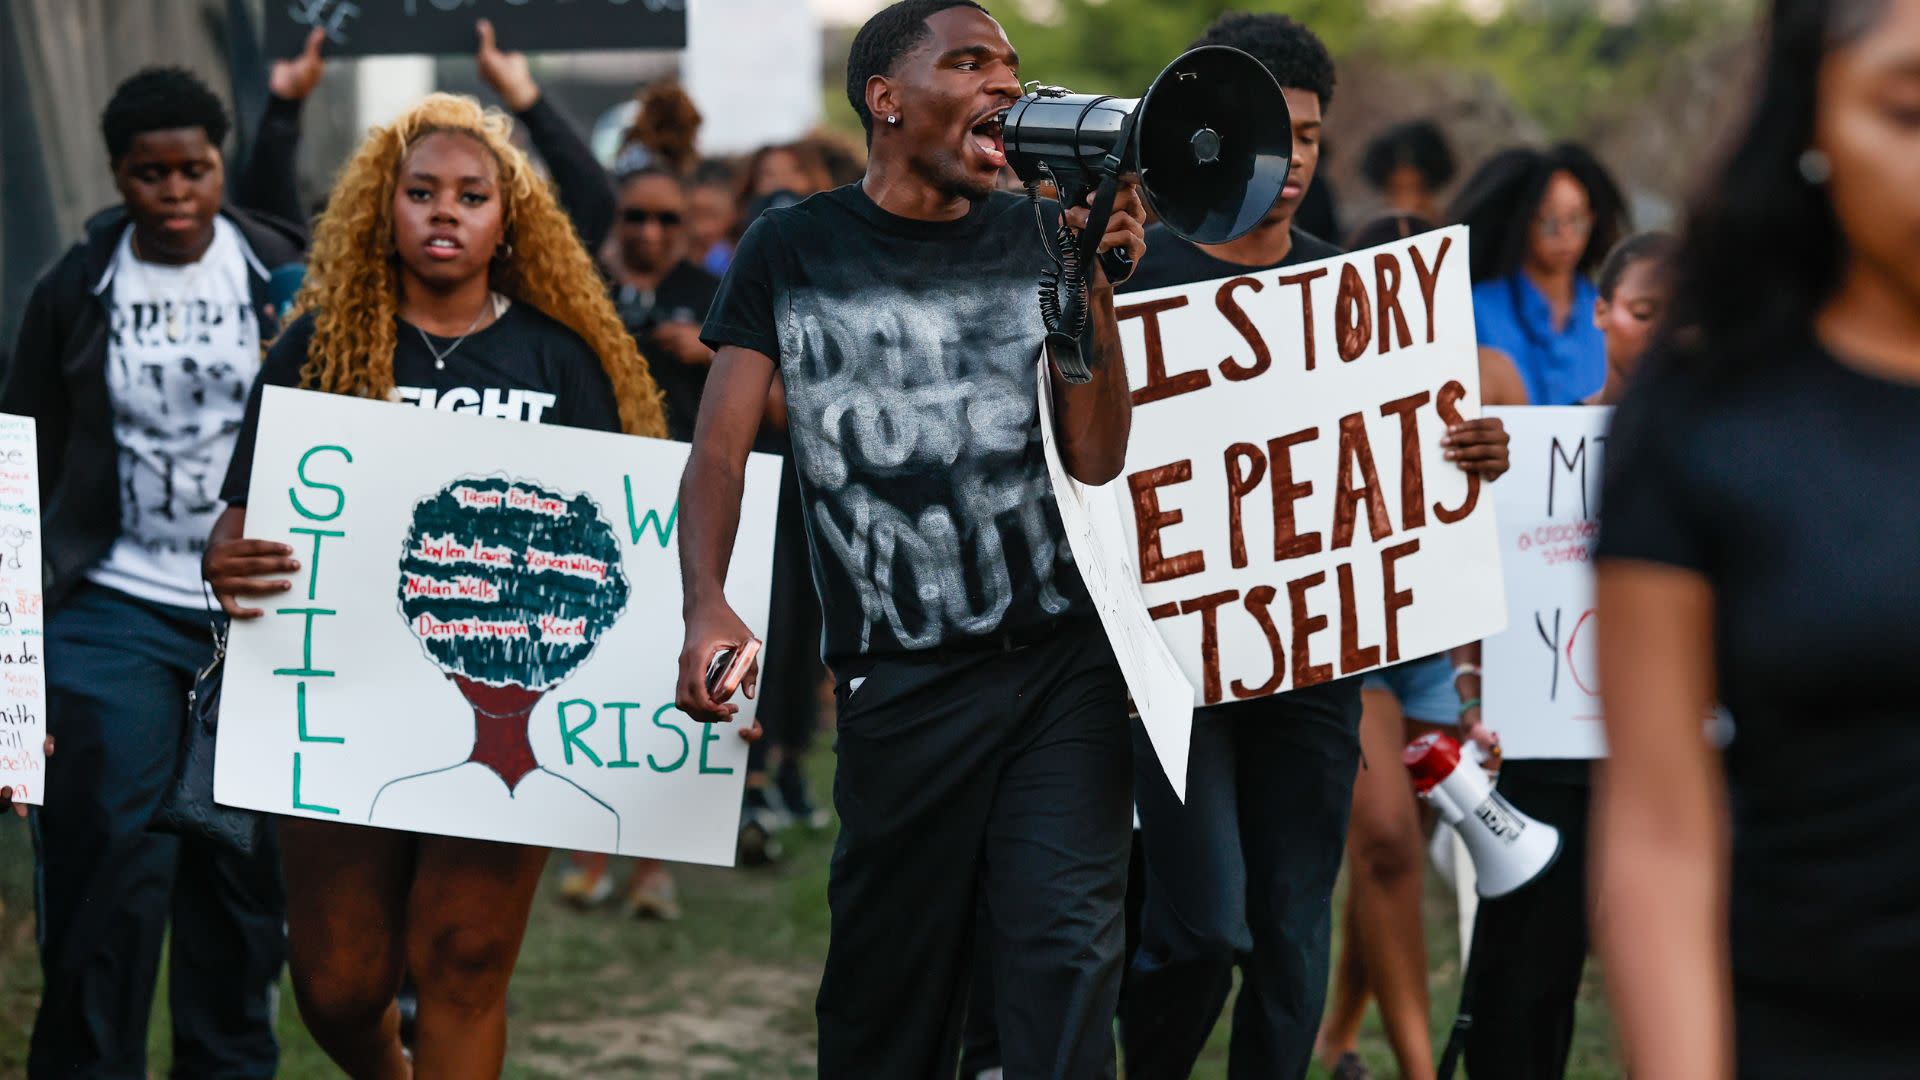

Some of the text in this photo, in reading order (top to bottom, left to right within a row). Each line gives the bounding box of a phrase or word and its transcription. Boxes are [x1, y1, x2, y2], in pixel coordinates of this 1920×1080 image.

[1115, 236, 1452, 407] ISTORY
[624, 474, 679, 548] W
[1127, 380, 1481, 584] EPEATS
[407, 577, 452, 595] Nolan
[0, 641, 38, 665] ade
[273, 444, 353, 814] STILL
[557, 698, 735, 775] RISE
